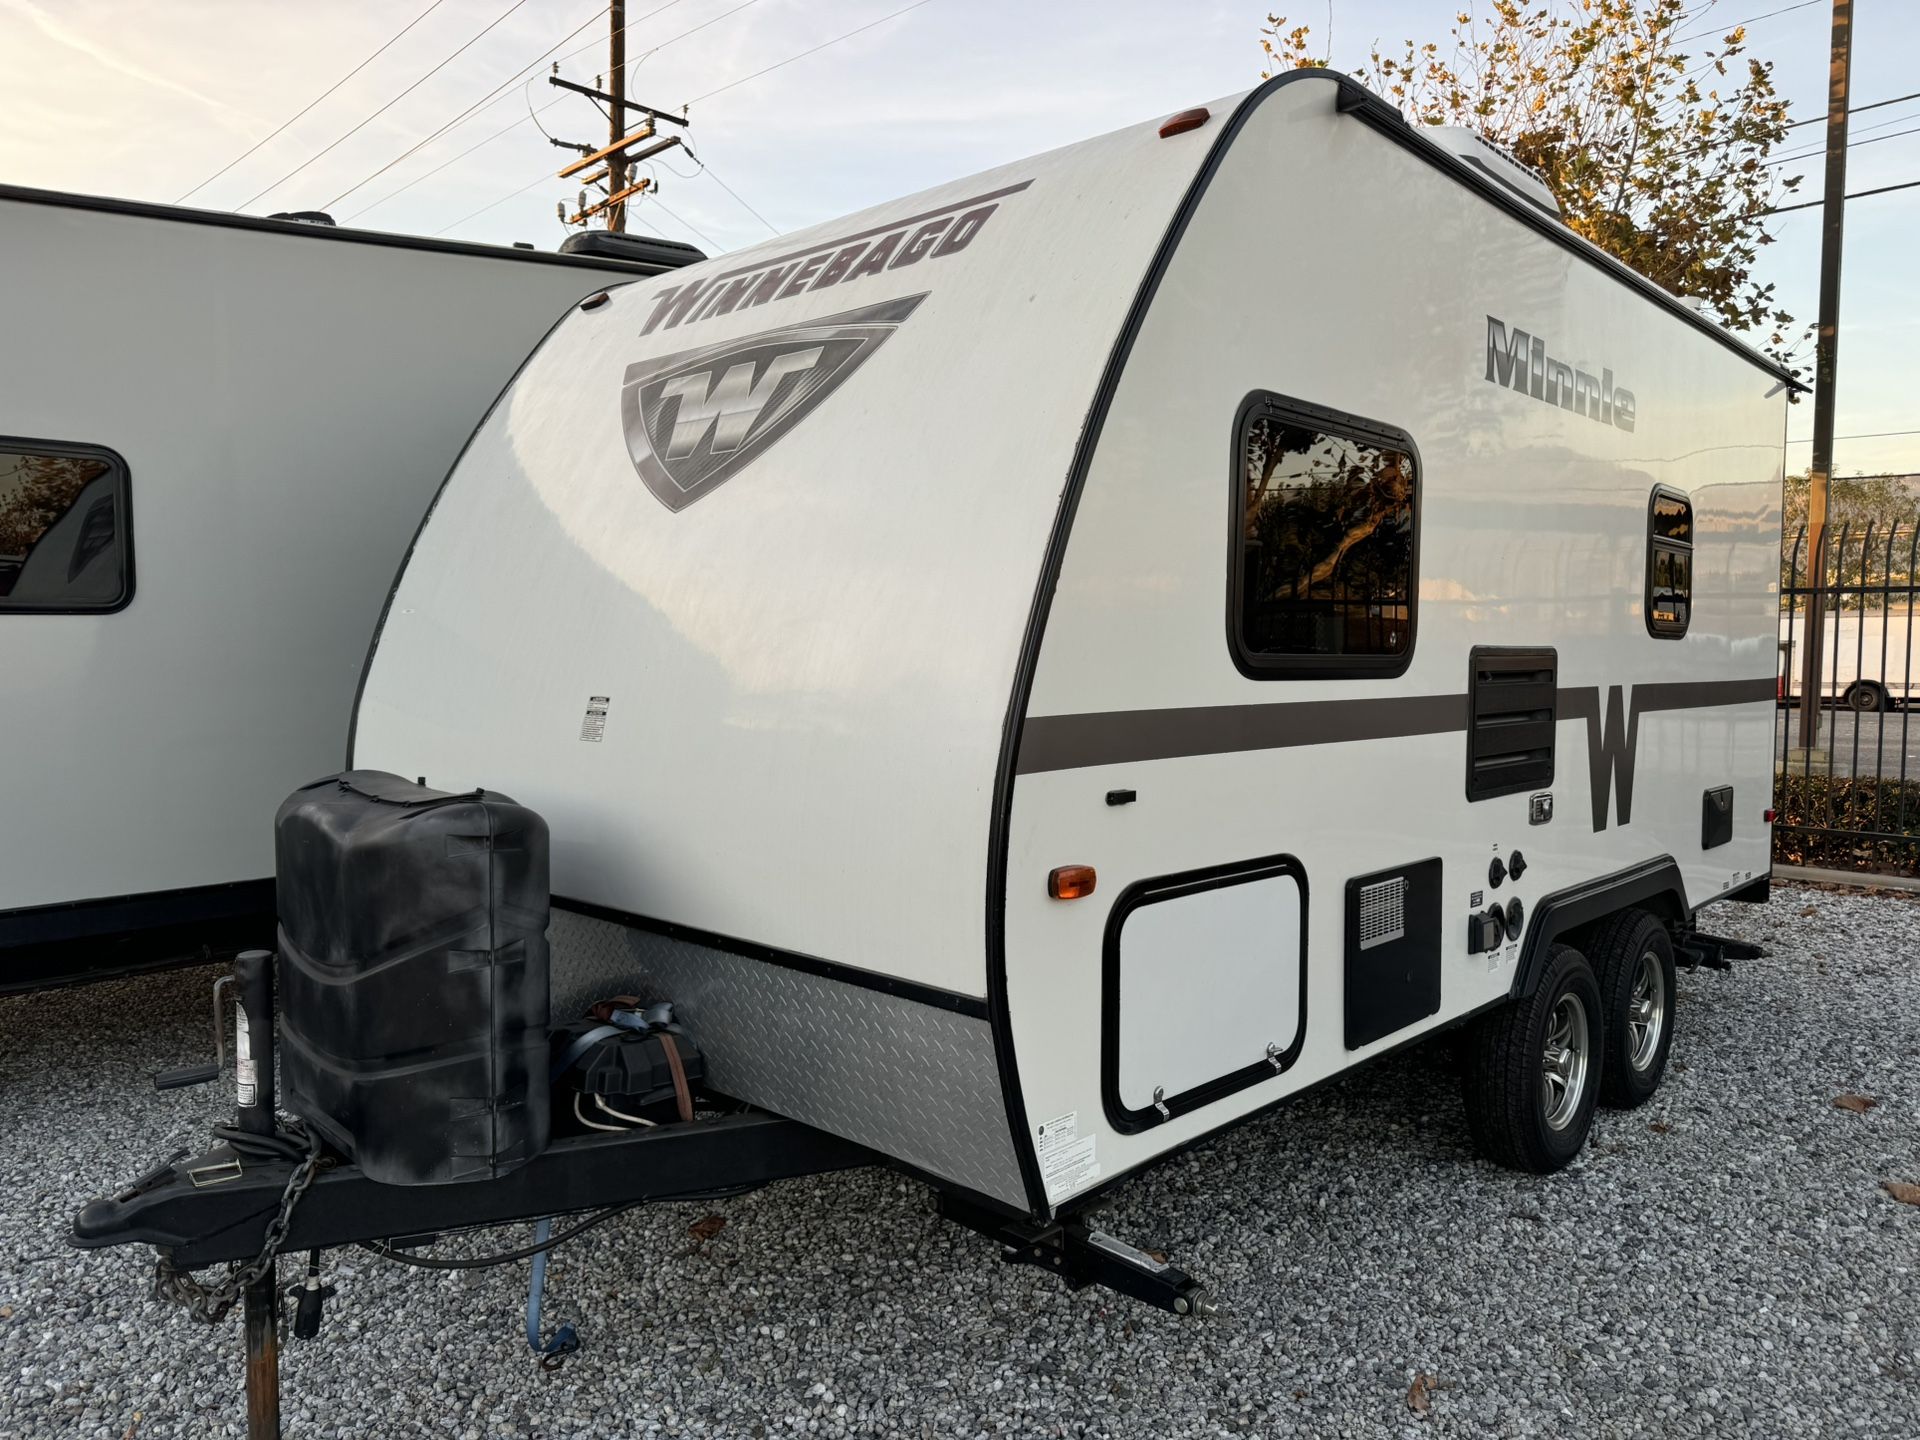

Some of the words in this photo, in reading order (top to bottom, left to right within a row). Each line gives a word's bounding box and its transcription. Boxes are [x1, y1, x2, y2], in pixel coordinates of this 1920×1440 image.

[638, 203, 1000, 337] WINNEBAGO
[659, 346, 825, 462] W
[1485, 314, 1636, 433] Minnie
[1587, 685, 1640, 834] W
